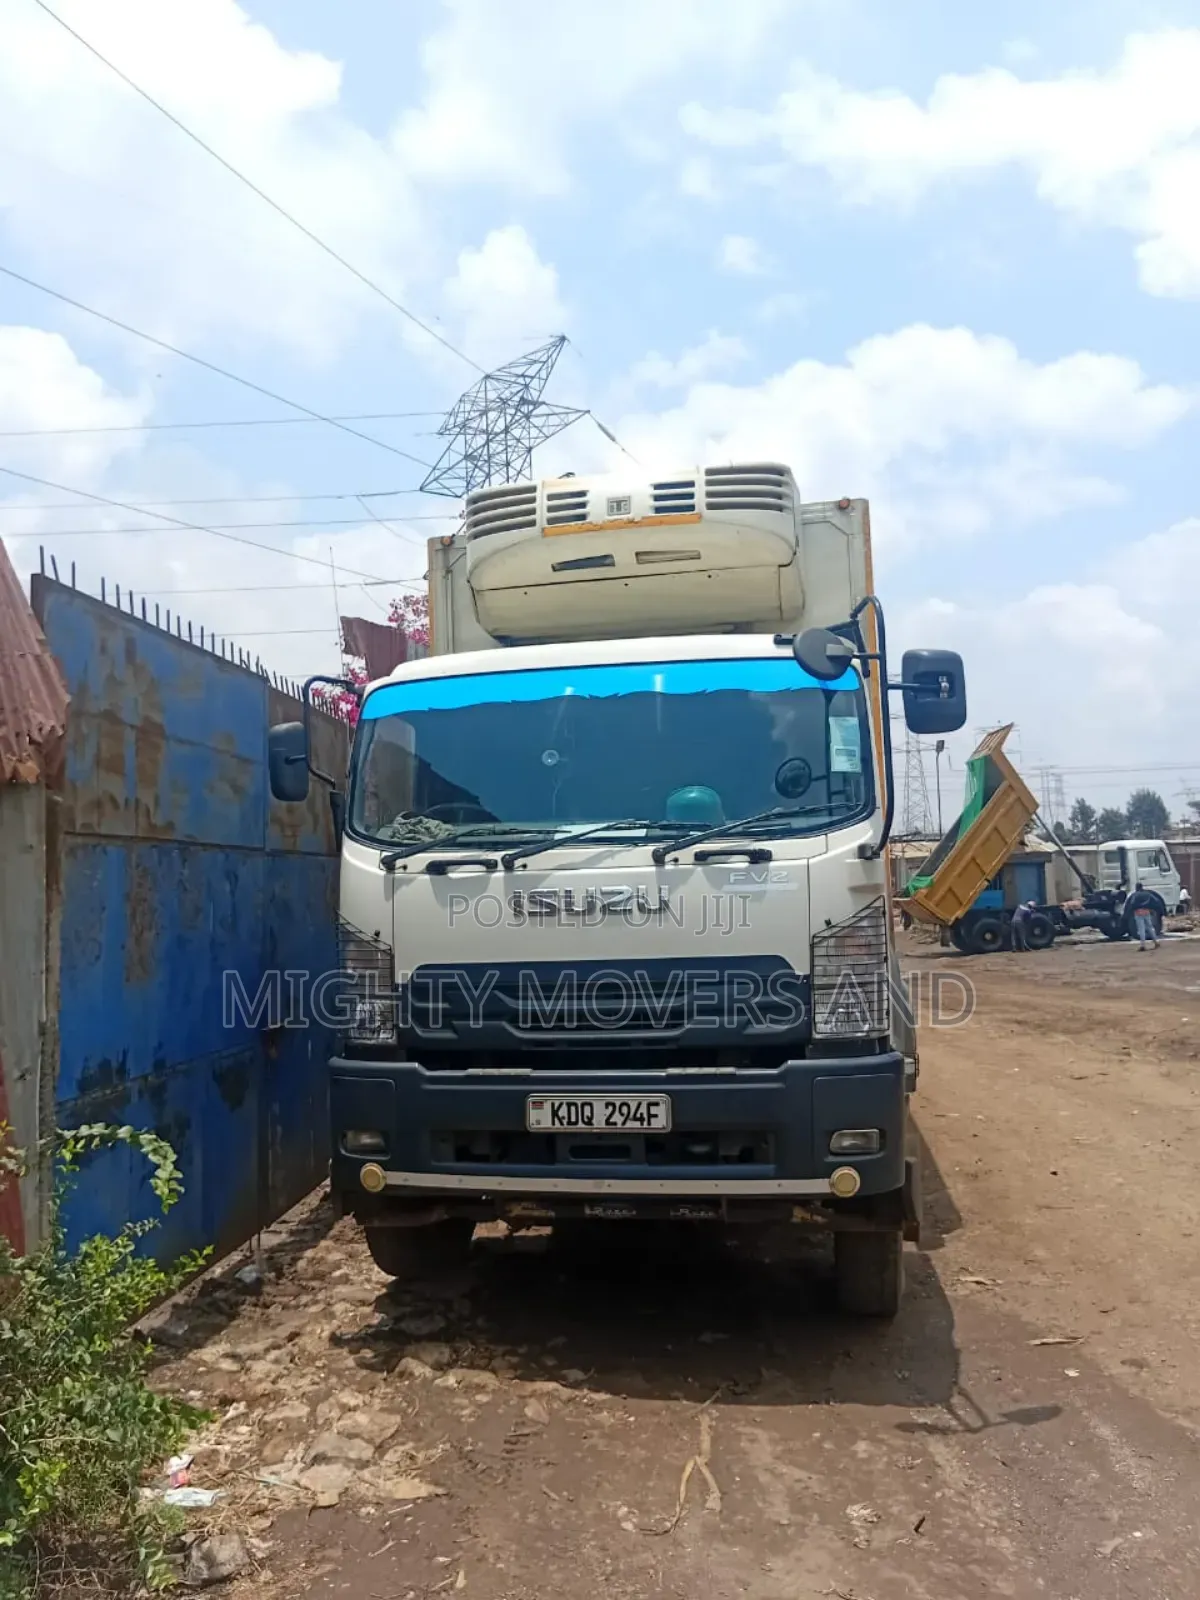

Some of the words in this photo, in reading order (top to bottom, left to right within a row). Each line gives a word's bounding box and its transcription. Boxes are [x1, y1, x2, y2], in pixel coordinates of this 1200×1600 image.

[513, 885, 669, 917] ISUZU
[551, 1101, 594, 1126] KDQ
[604, 1101, 660, 1126] 294F
